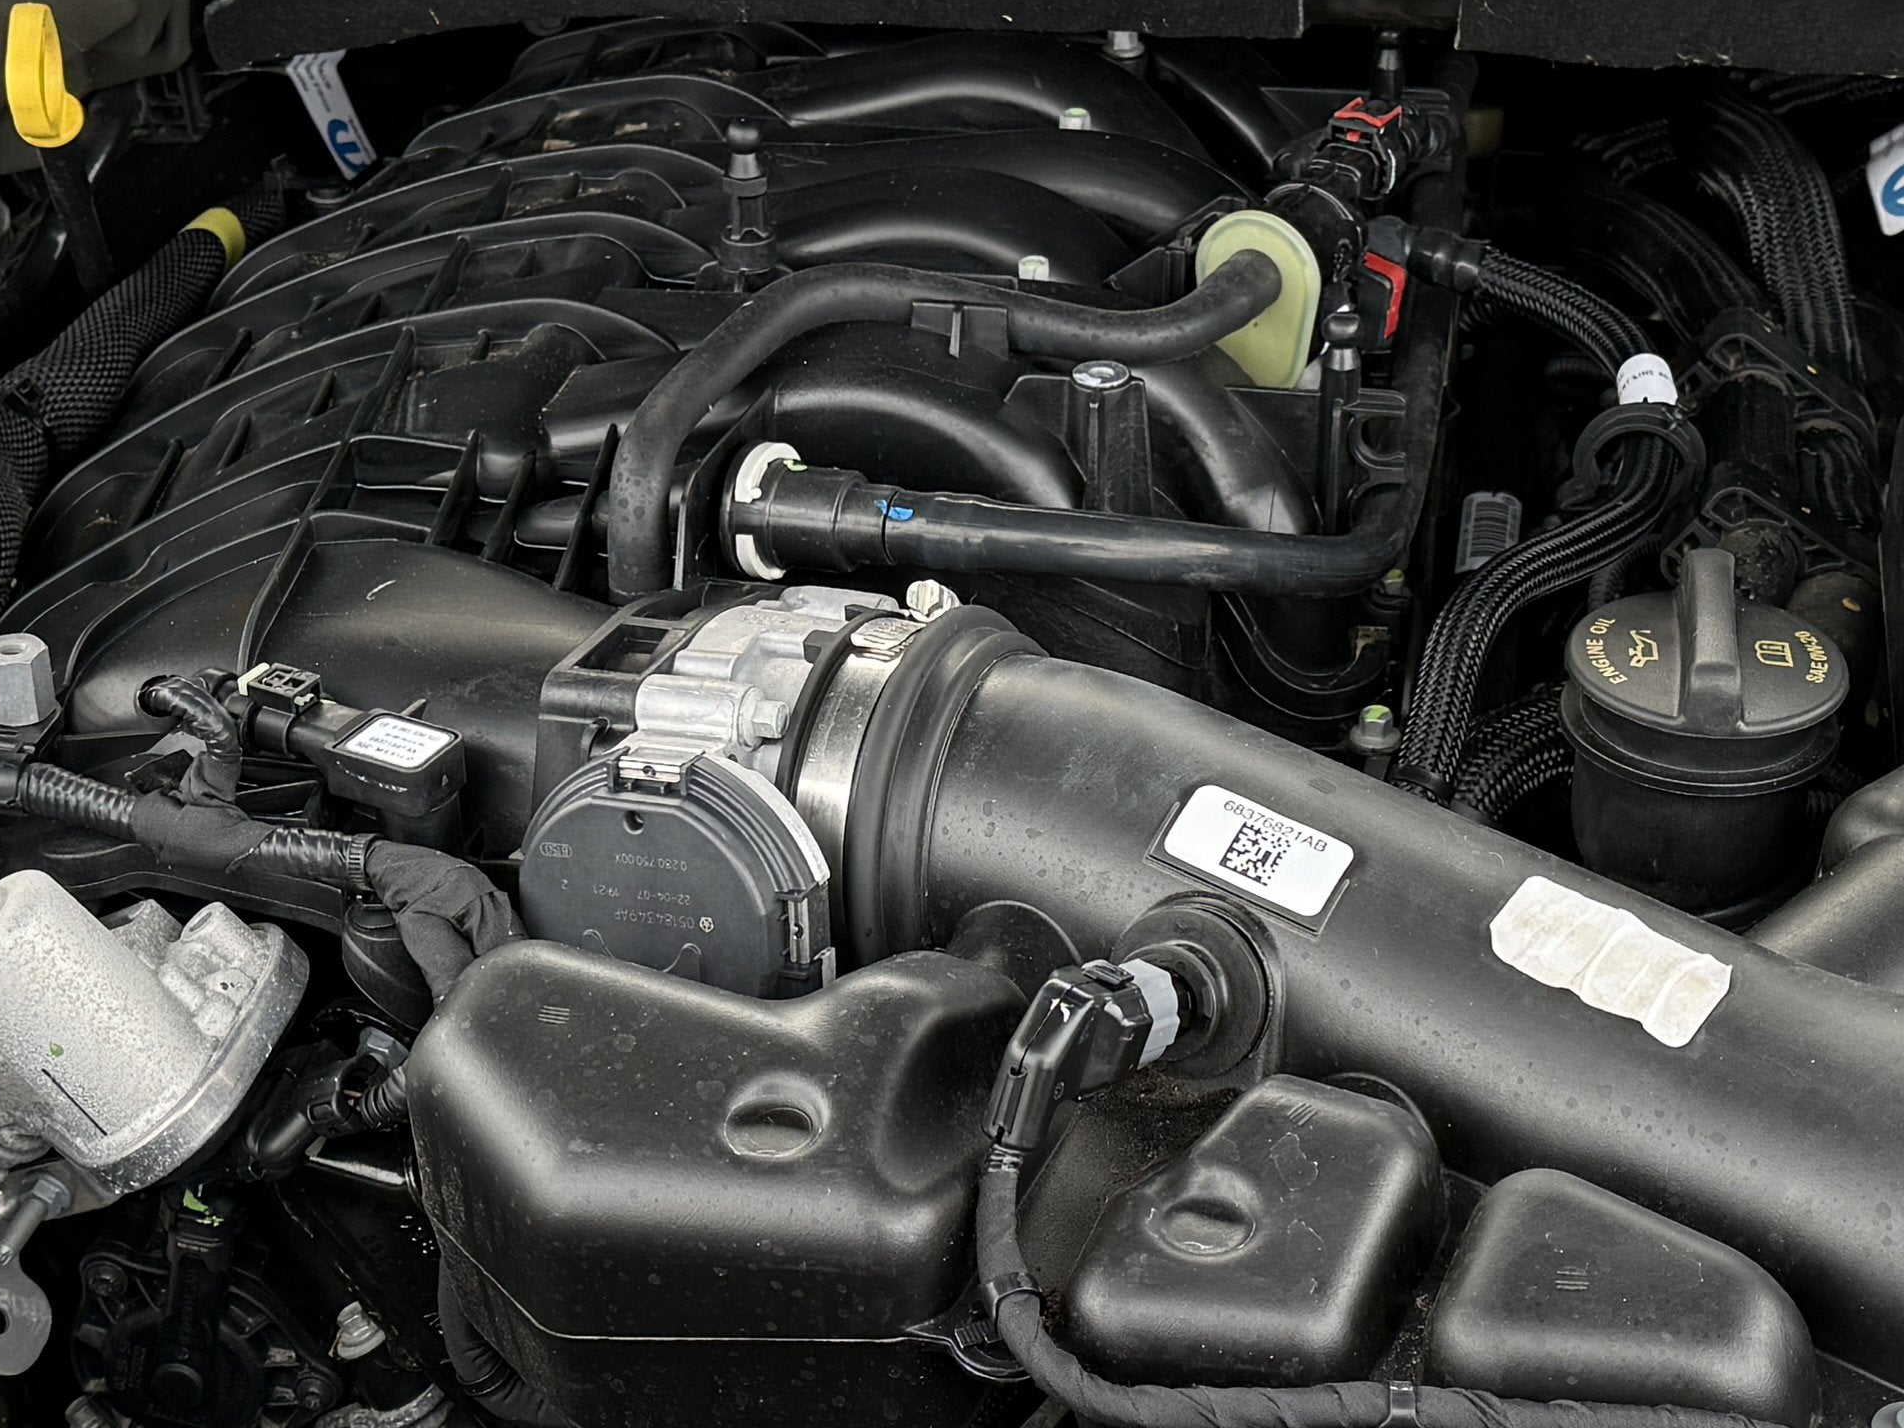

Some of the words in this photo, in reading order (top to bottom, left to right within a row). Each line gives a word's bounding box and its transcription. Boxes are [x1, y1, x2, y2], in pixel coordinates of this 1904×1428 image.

[1589, 618, 1616, 635] OIL
[1585, 638, 1628, 685] ENGINE
[1806, 661, 1829, 684] SAE
[1223, 800, 1328, 852] 68376821AB
